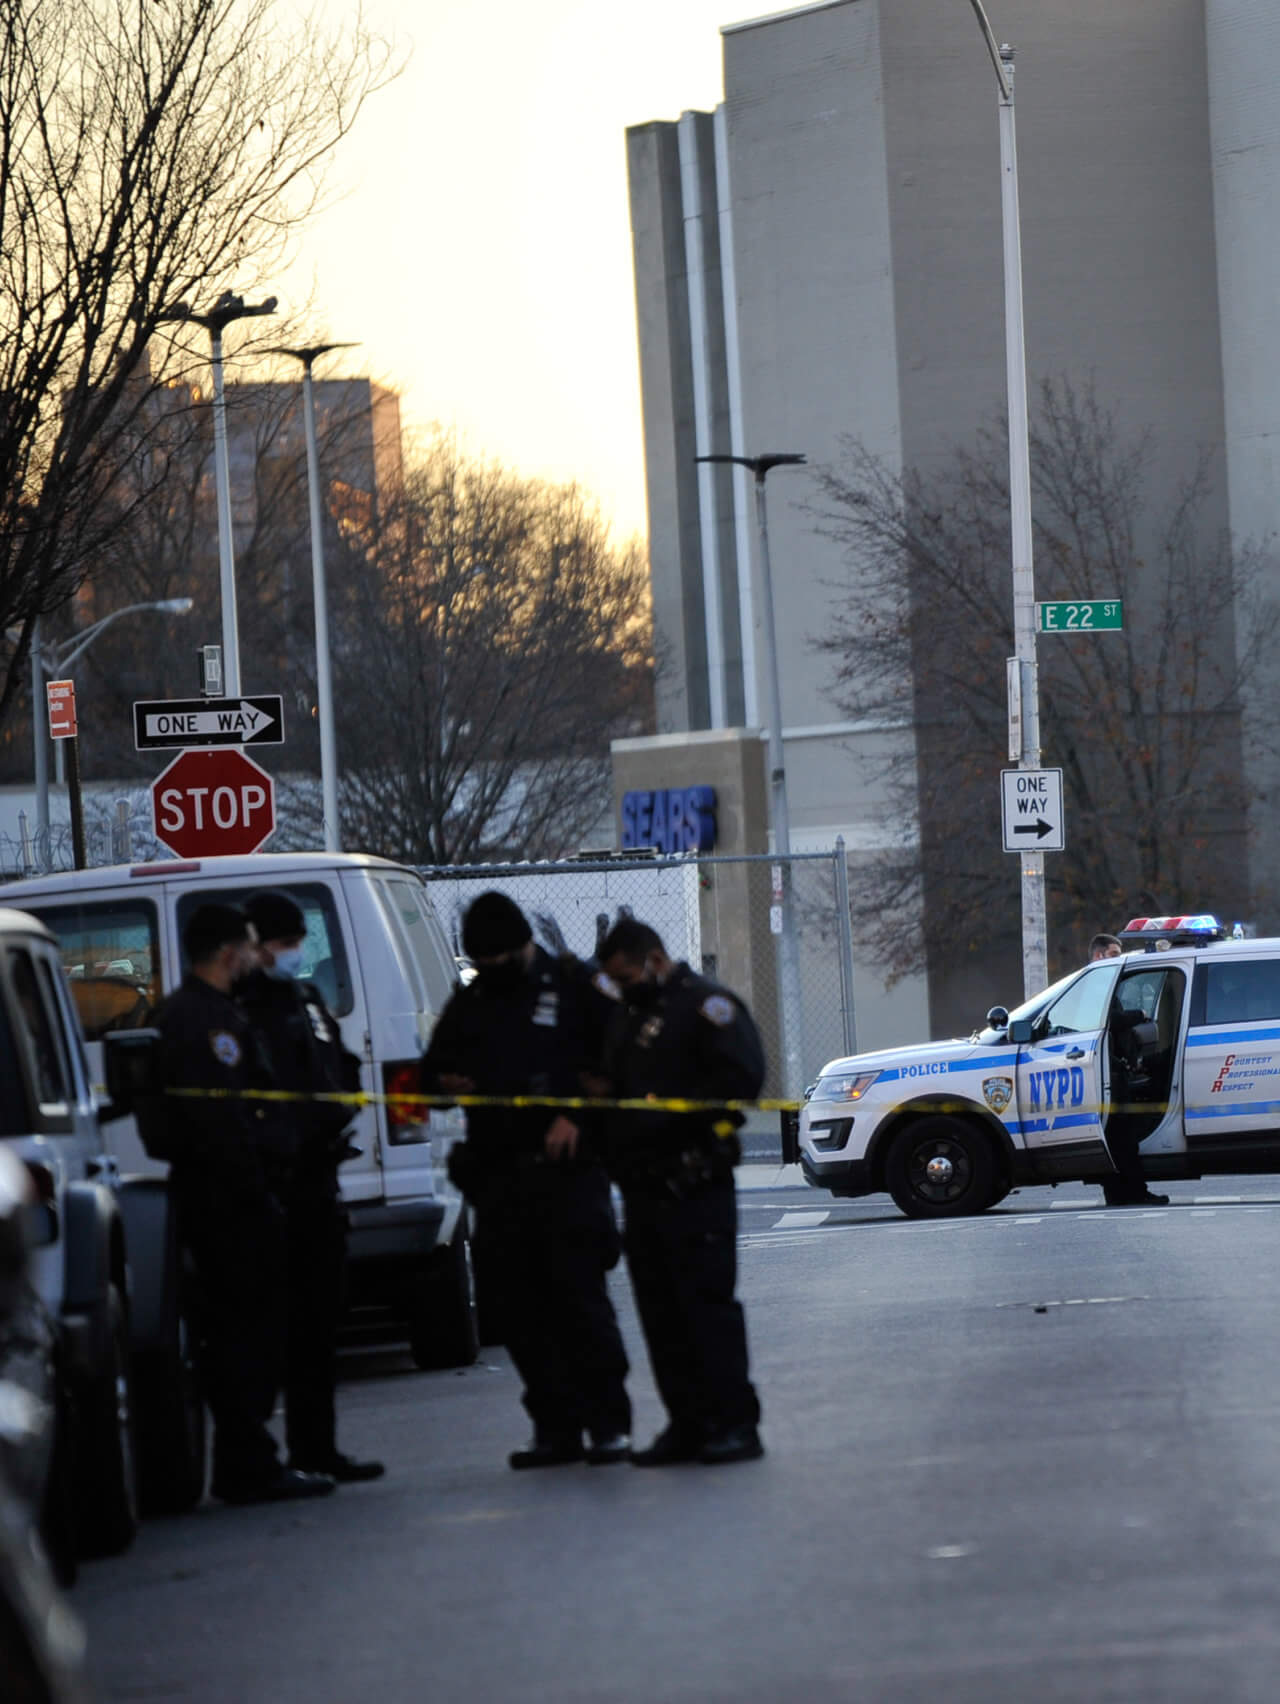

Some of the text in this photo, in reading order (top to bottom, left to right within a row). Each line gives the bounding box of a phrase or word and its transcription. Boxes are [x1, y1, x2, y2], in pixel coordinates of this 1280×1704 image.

[1045, 604, 1117, 628] E 22 ST
[157, 712, 260, 734] ONE WAY
[1017, 777, 1047, 793] ONE
[160, 785, 266, 832] STOP
[1017, 798, 1048, 813] WAY
[621, 785, 712, 853] SEARS
[901, 1062, 947, 1079] POLICE
[1029, 1066, 1084, 1113] NYPD
